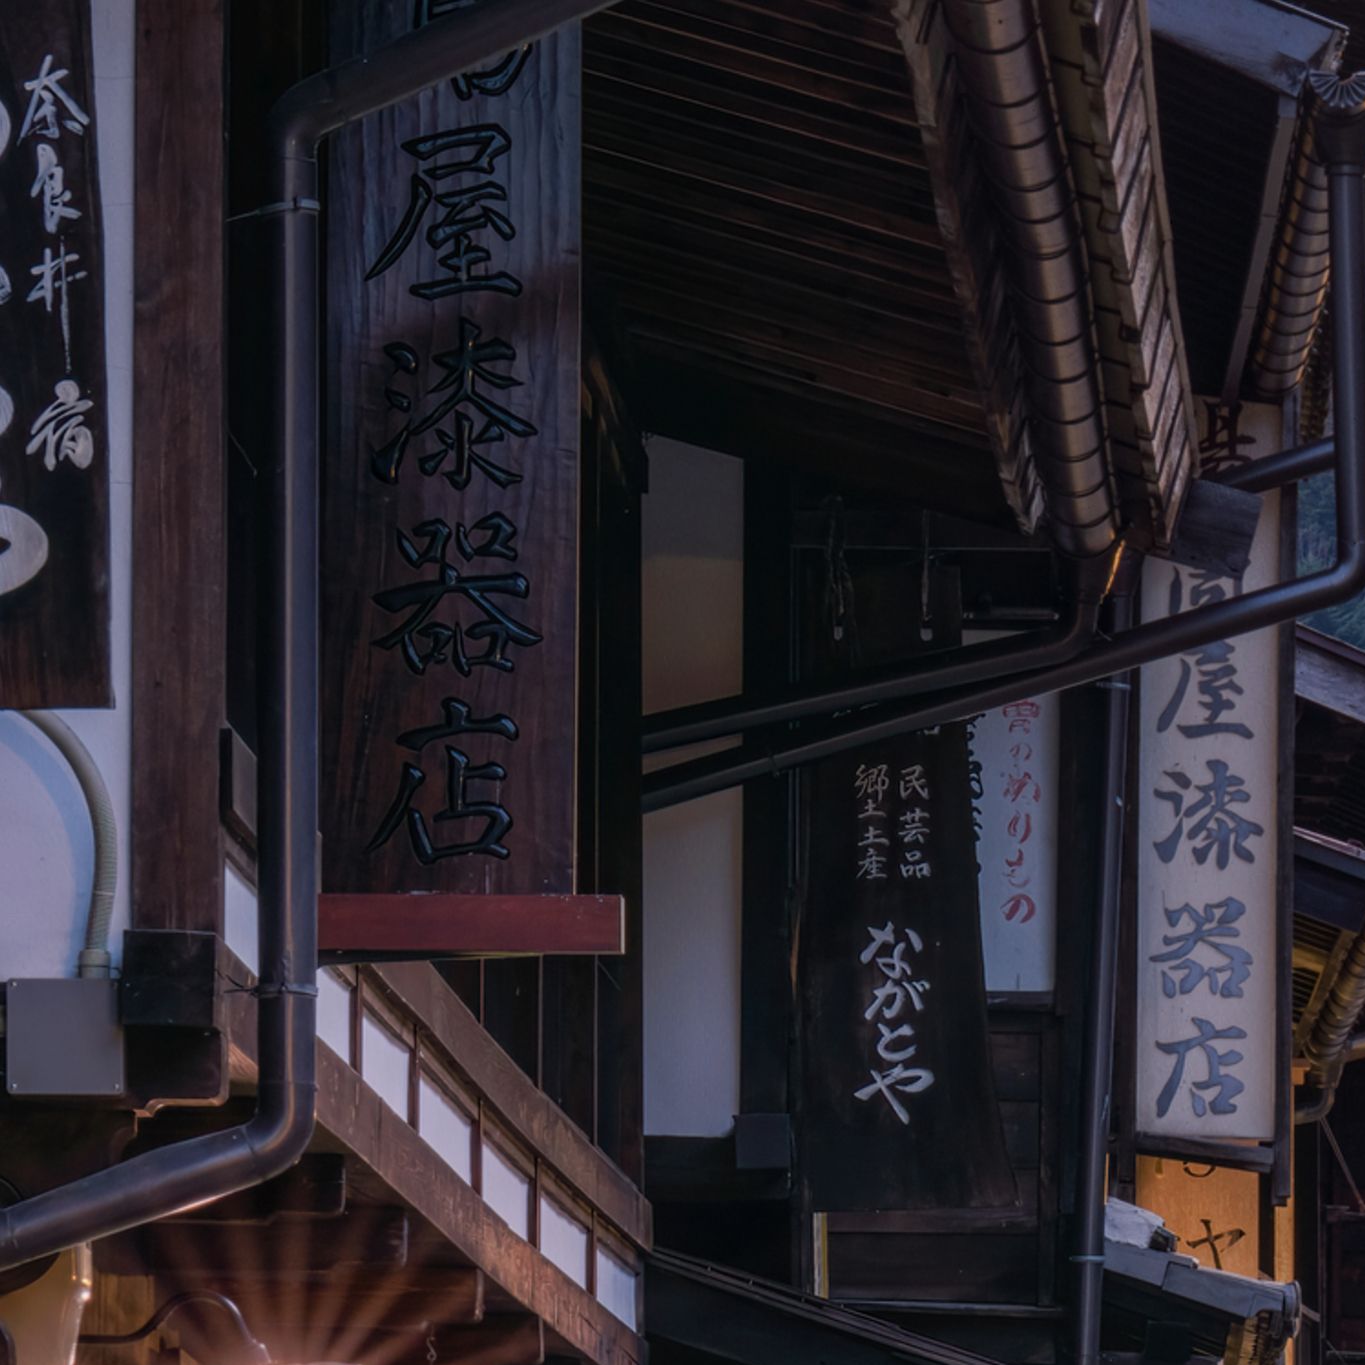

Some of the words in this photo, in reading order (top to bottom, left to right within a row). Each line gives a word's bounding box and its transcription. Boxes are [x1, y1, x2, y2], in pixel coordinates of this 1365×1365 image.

[364, 0, 544, 866] 屋漆器店
[854, 763, 891, 881] 郷土土産
[898, 763, 932, 880] 民芸品
[854, 920, 935, 1125] ながとや
